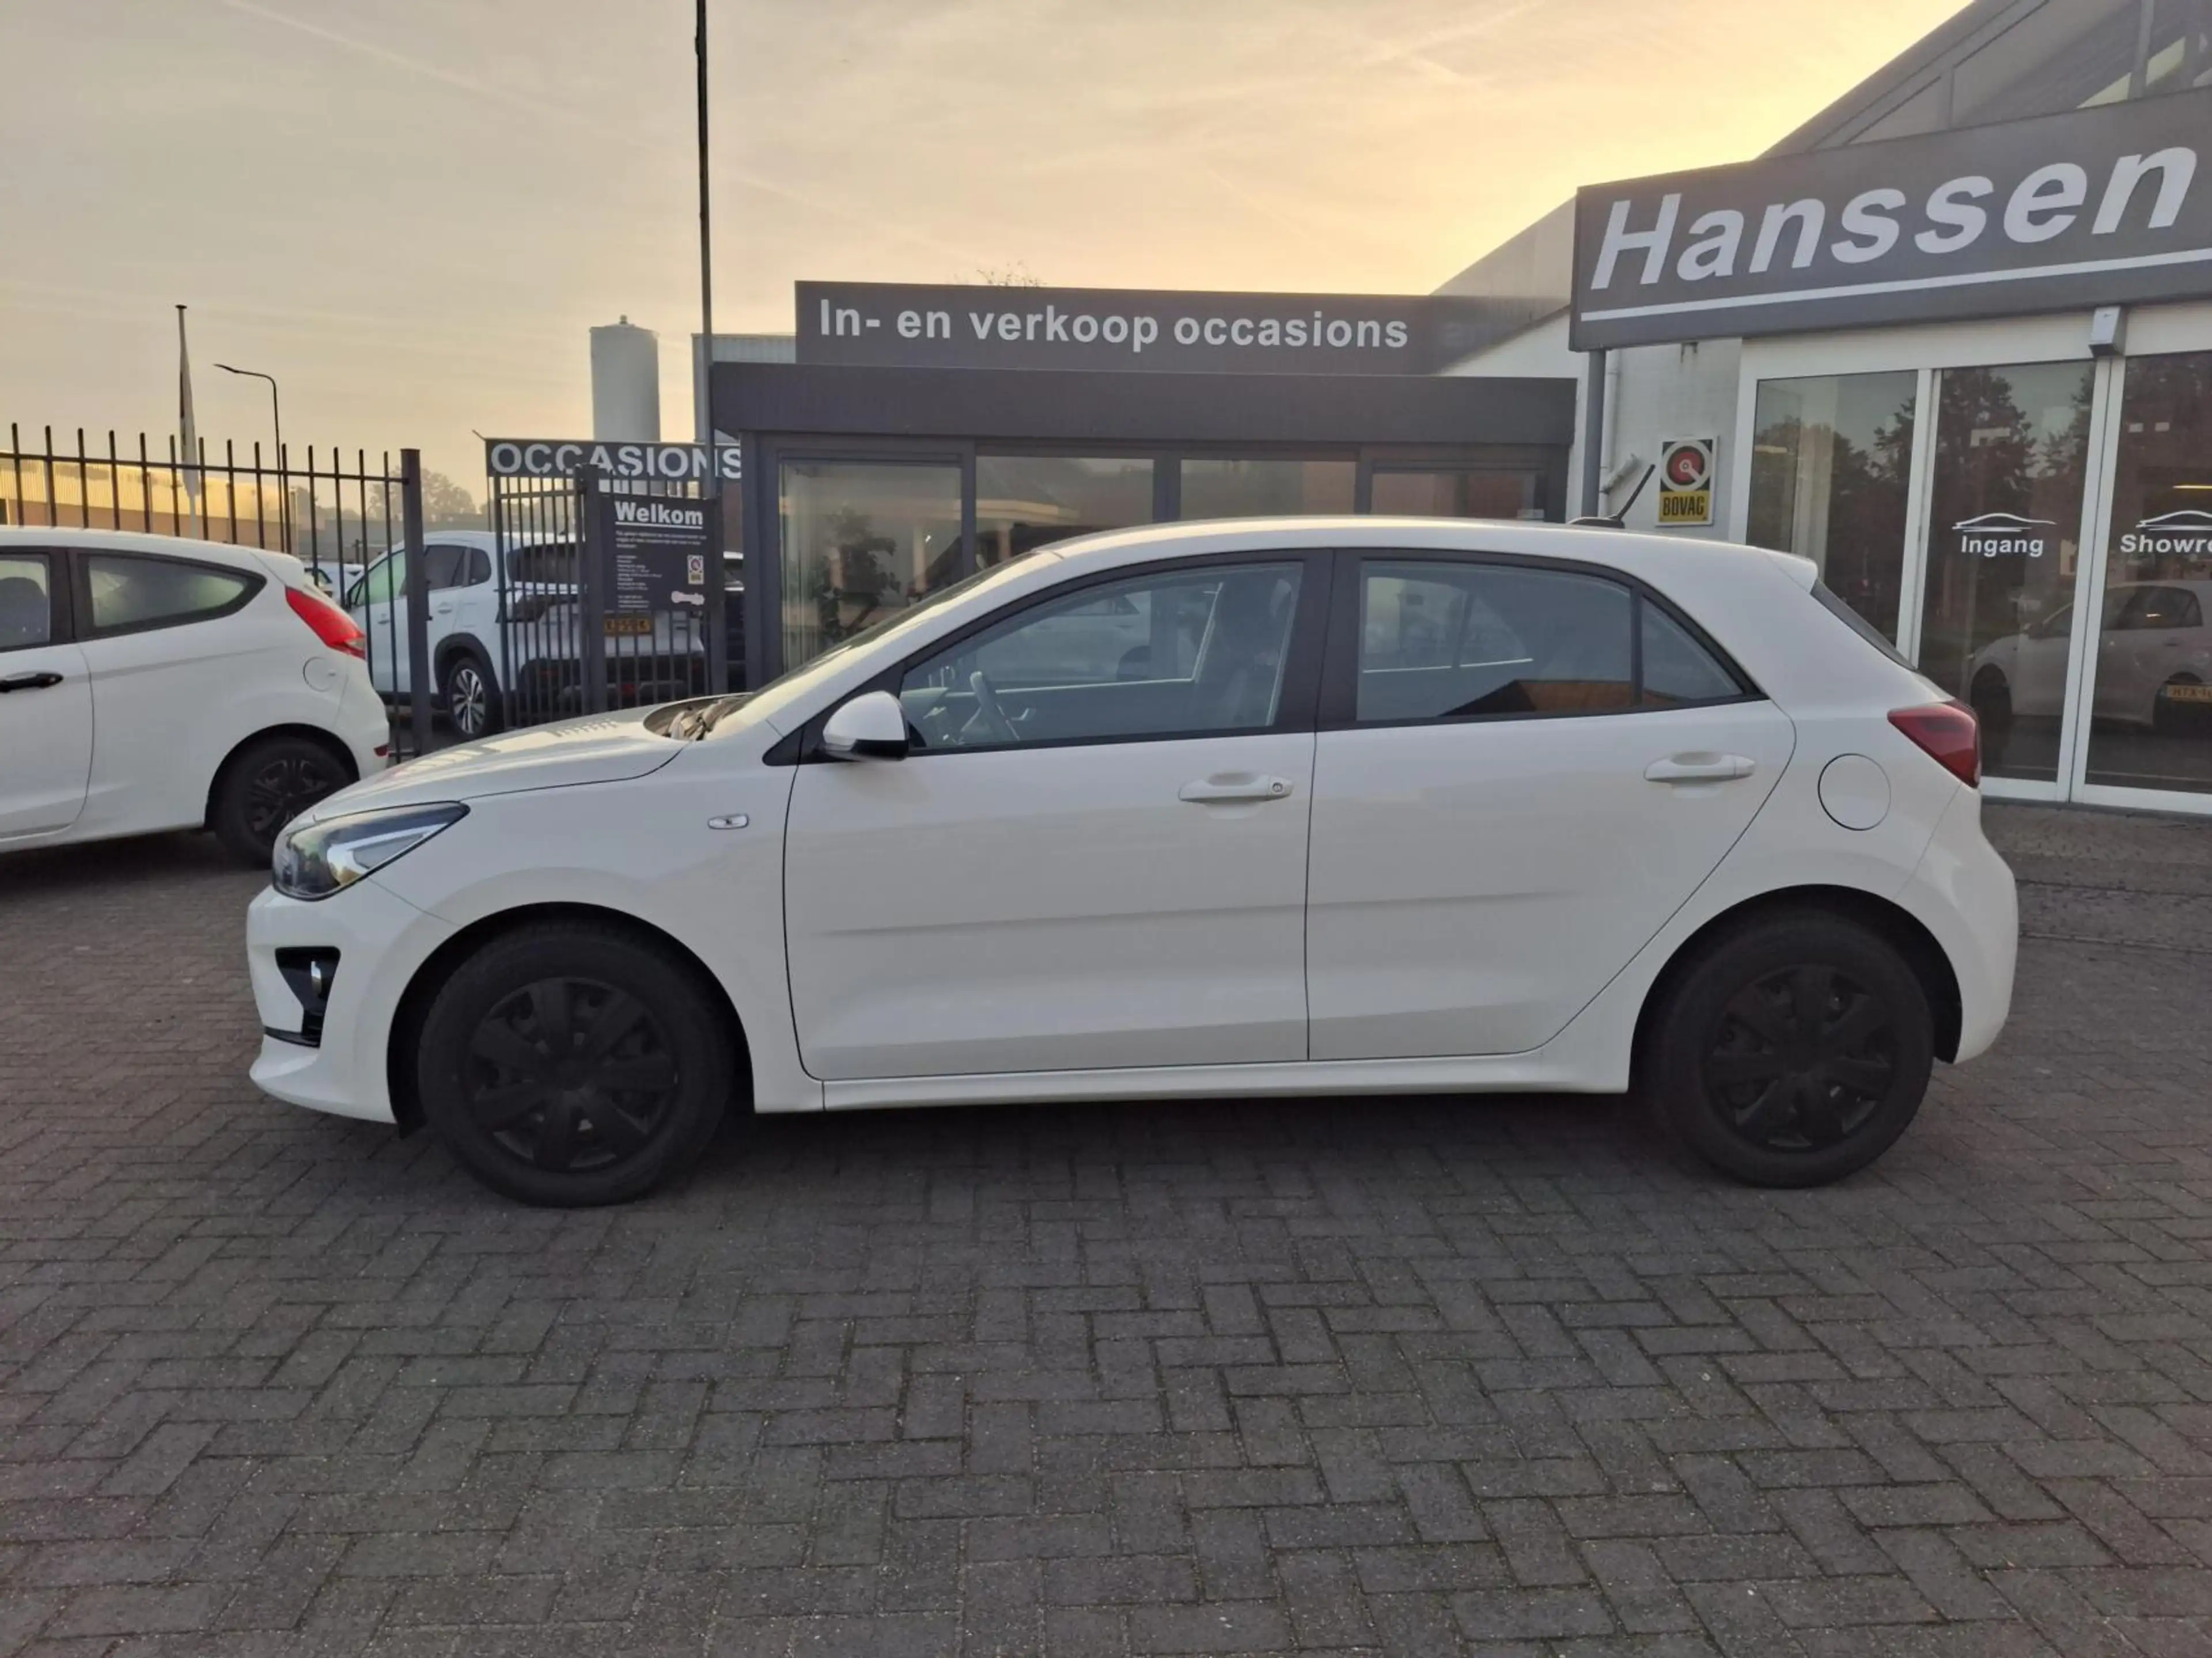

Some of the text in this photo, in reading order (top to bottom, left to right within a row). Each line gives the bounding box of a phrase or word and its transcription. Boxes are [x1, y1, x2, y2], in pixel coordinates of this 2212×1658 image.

[1590, 146, 2198, 291] Hanssen
[820, 299, 1408, 353] In- en verkoop occasions
[614, 500, 703, 525] Welkom
[1662, 496, 1705, 516] BOVAG
[1961, 535, 2044, 557] Ingang
